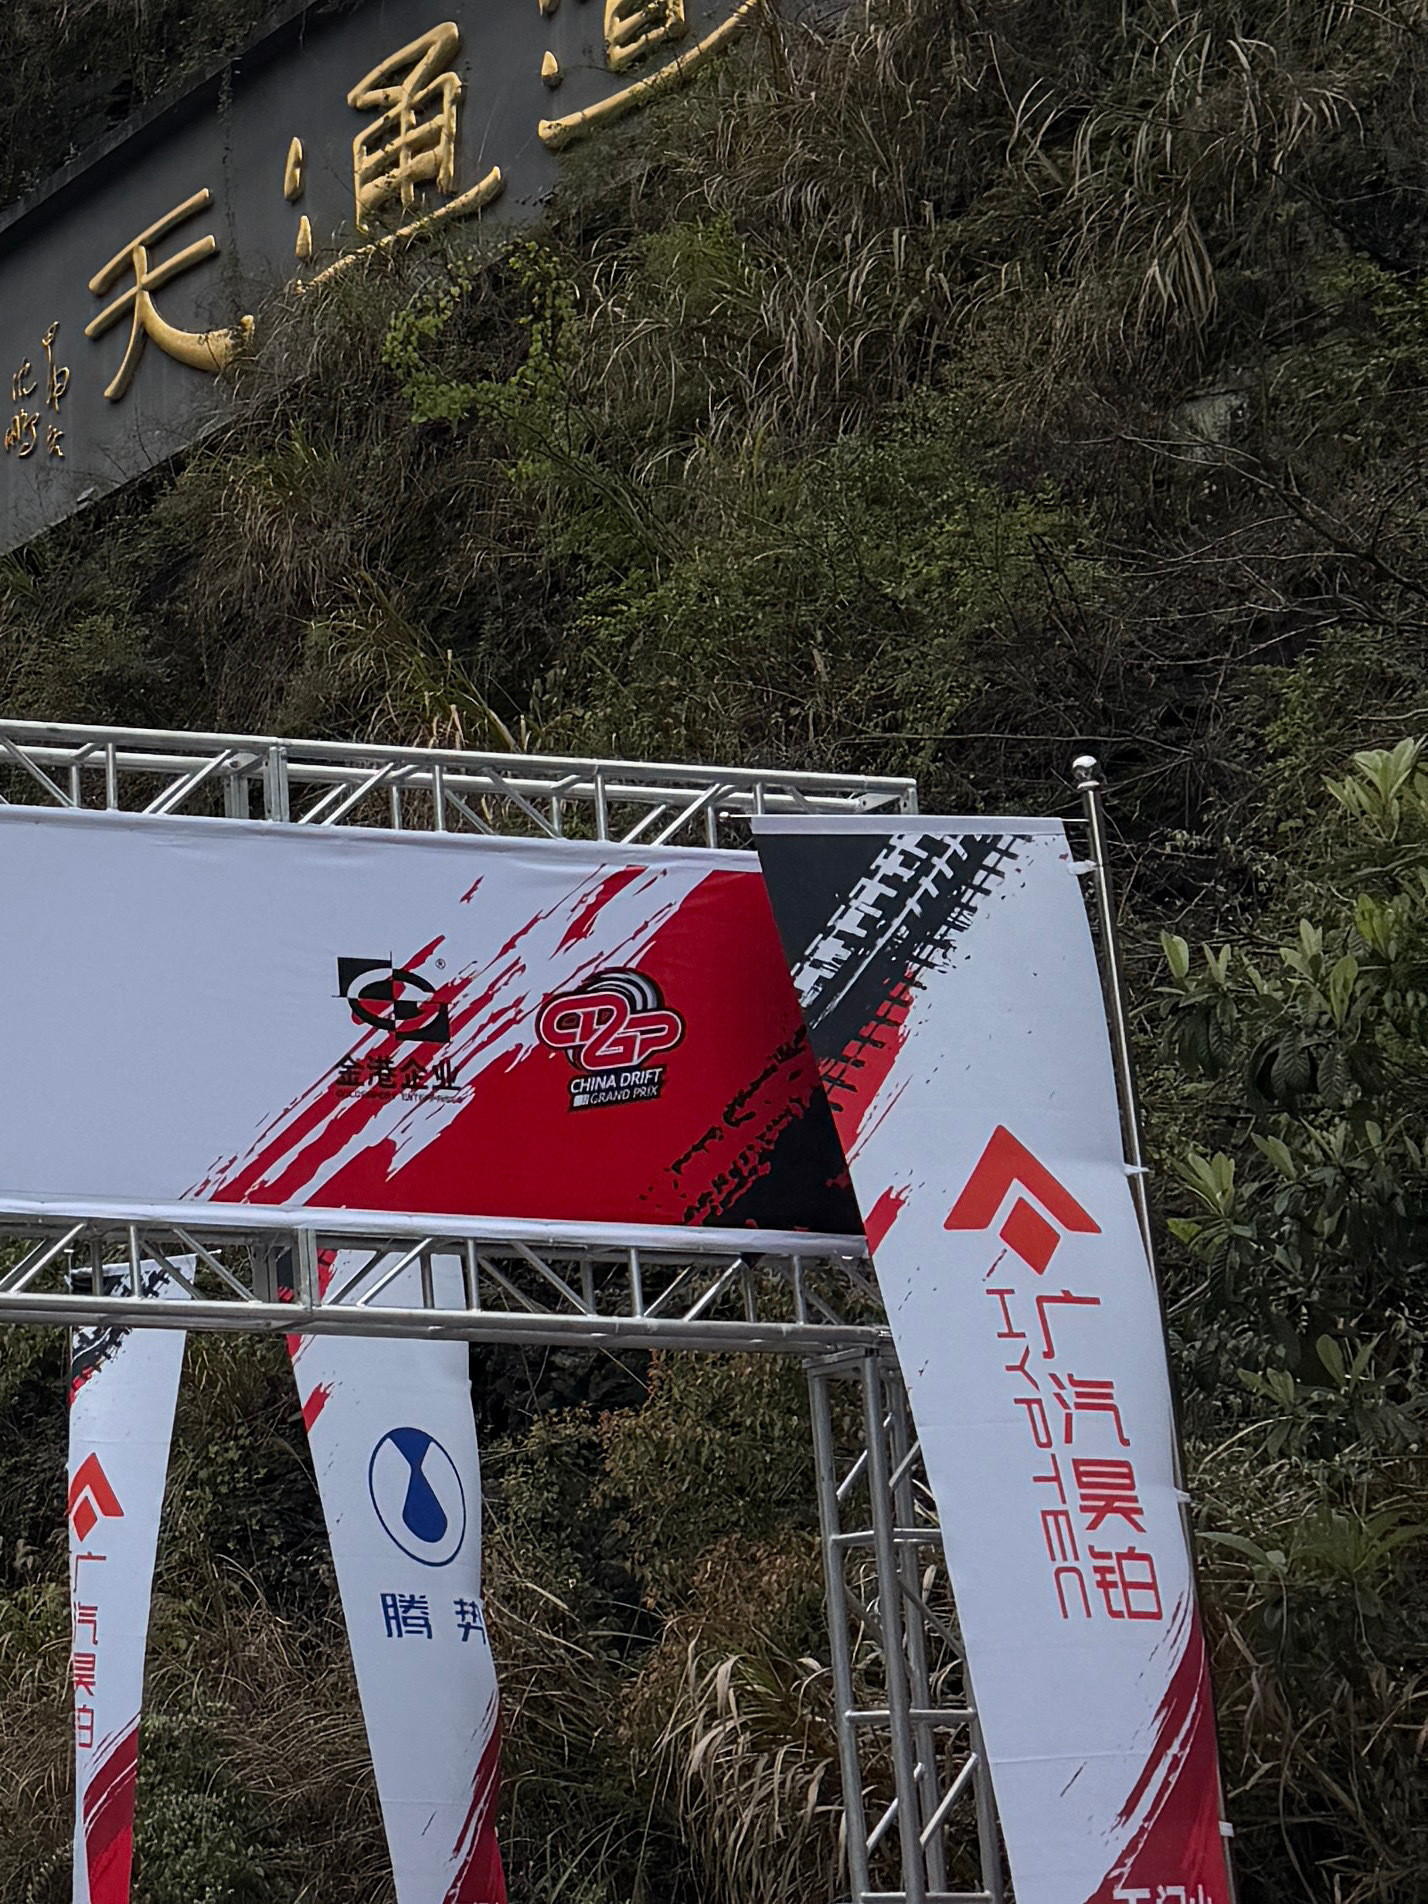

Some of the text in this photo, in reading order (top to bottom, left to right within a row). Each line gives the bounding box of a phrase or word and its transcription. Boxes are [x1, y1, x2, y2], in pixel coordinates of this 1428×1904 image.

[336, 1054, 462, 1089] 金港企业
[570, 1067, 663, 1094] CHINA DRIFT
[589, 1084, 659, 1105] GRAND PRIX
[985, 1288, 1093, 1620] HYPTEC
[1035, 1288, 1163, 1621] 广汽昊铂
